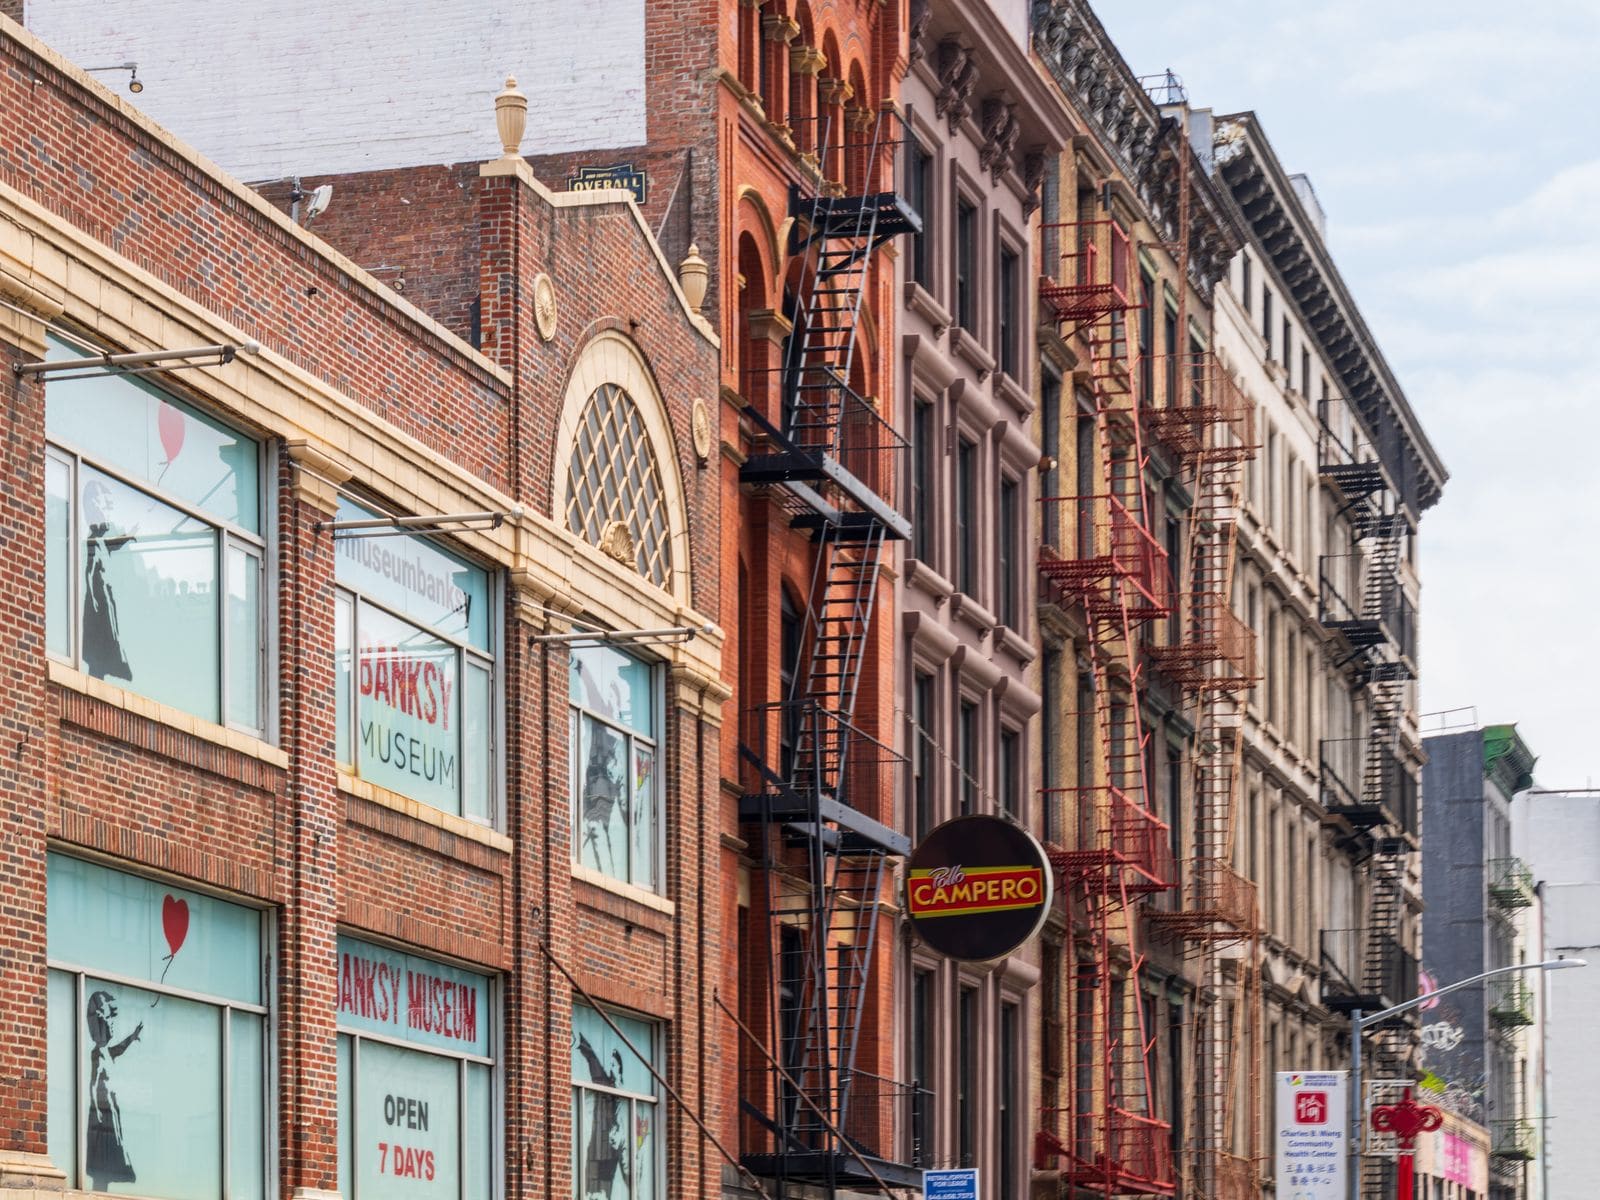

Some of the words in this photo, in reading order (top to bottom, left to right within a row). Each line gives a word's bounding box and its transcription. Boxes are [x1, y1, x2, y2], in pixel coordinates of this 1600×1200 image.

[360, 645, 452, 730] BANKSY
[361, 720, 455, 790] MUSEUM
[914, 877, 1038, 905] CAMPERO
[928, 864, 965, 889] Pollo
[336, 952, 401, 1025] ANKSY
[408, 970, 477, 1043] MUSEUM
[384, 1094, 429, 1132] OPEN
[378, 1142, 388, 1174] 7
[394, 1145, 435, 1181] DAYS
